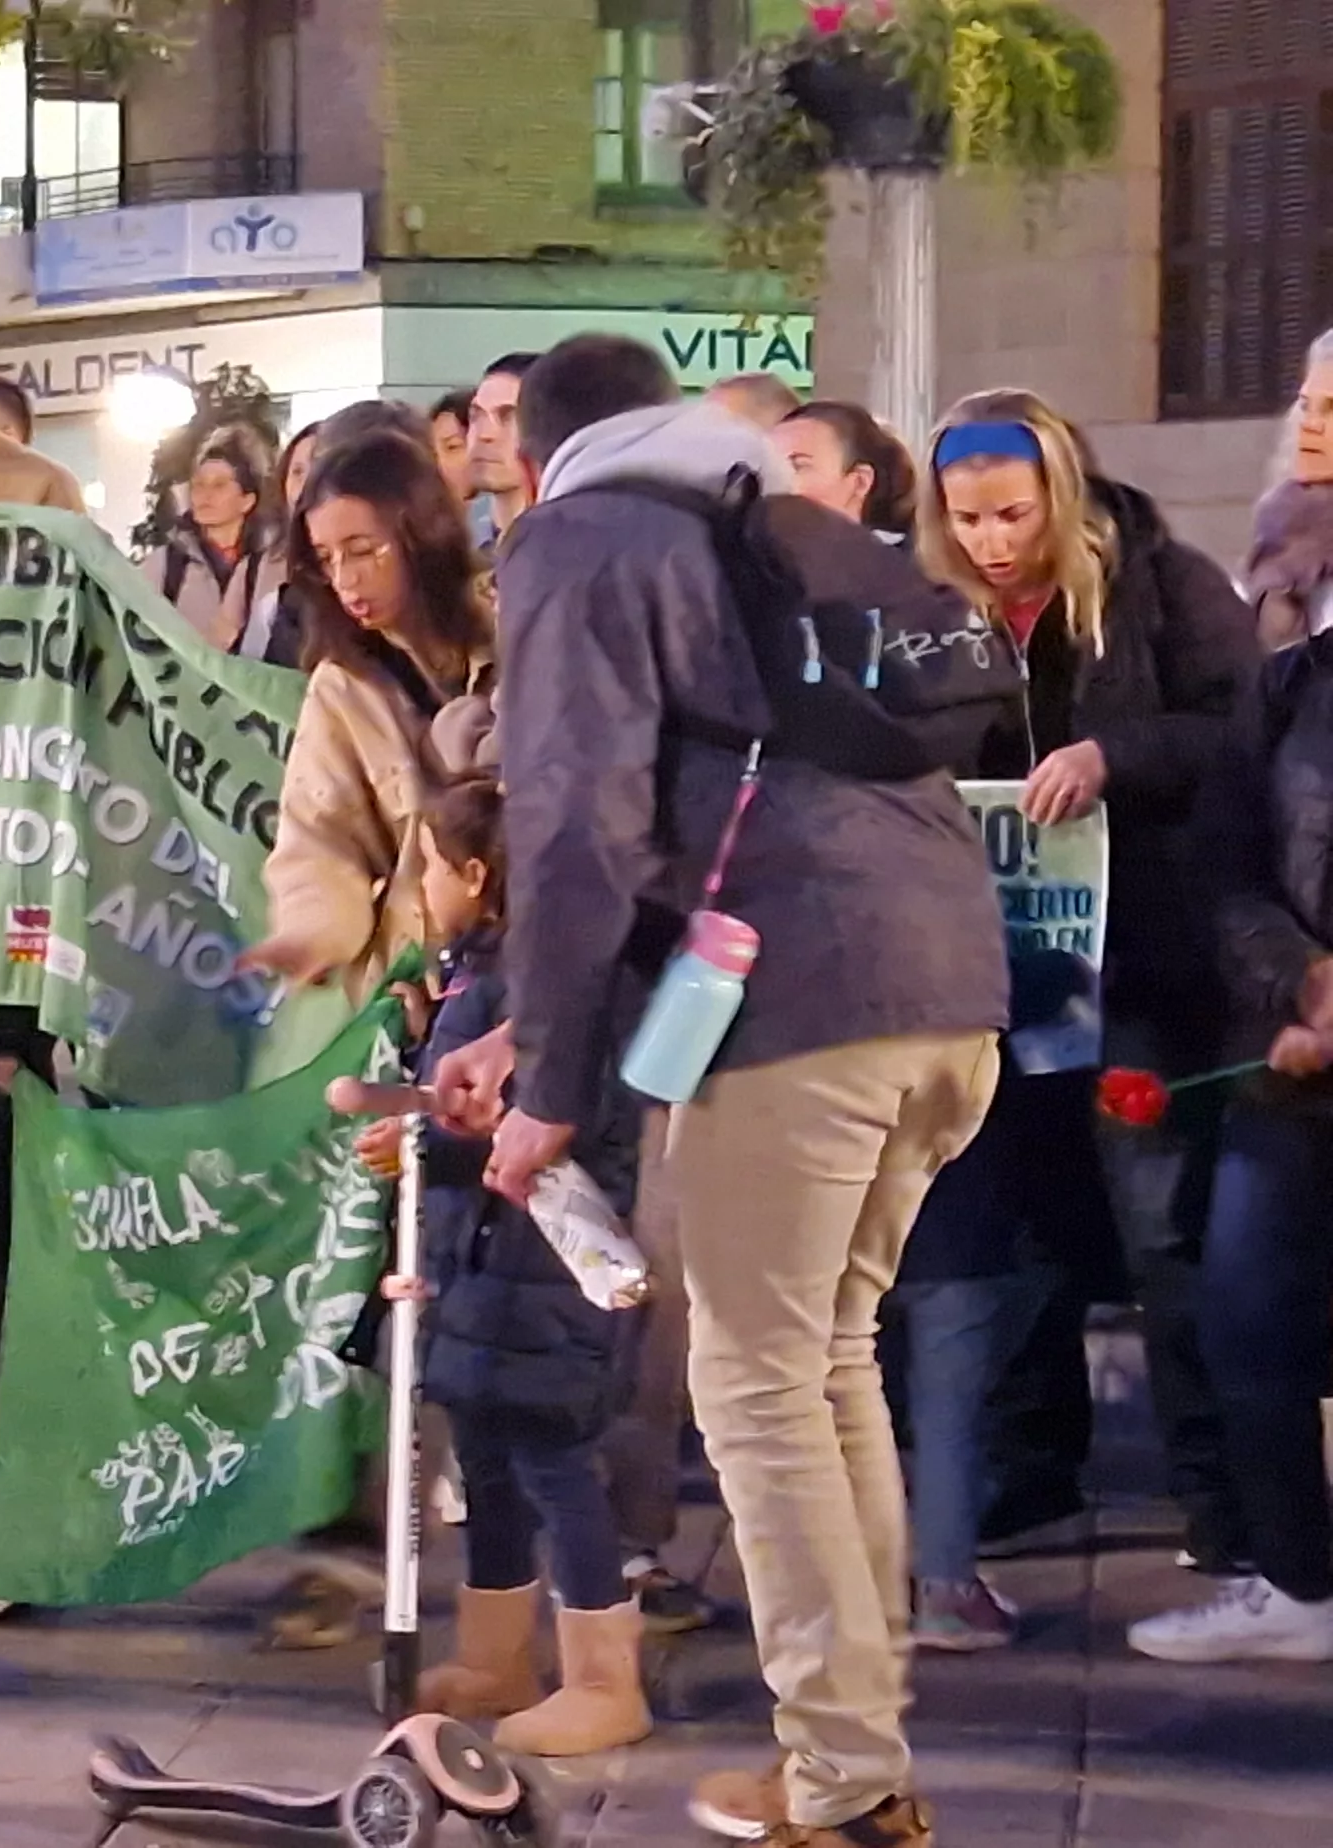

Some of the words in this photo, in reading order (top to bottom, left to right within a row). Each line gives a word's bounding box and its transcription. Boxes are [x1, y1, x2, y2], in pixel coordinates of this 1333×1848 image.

[149, 816, 241, 920] DEL
[968, 804, 1039, 877] O!
[59, 1168, 239, 1251] SCUELA
[129, 1321, 210, 1396] DE
[120, 1442, 245, 1524] PAR
